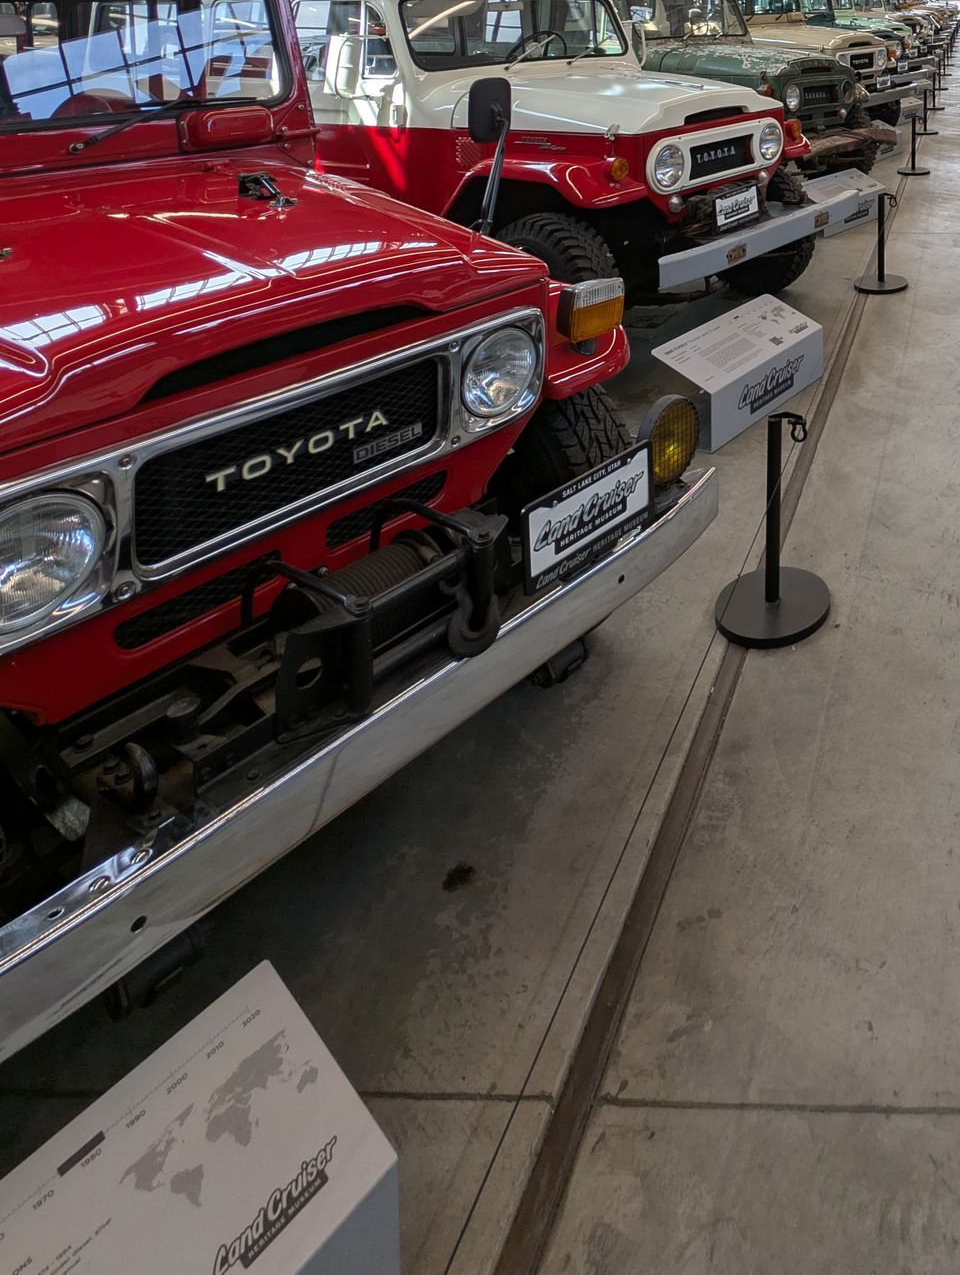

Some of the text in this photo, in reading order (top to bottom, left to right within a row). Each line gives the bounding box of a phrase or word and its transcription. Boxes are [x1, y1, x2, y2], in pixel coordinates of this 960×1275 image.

[738, 354, 804, 410] Land Cruiser
[205, 409, 389, 492] TOYOTA
[355, 423, 422, 463] DIESEL
[562, 460, 621, 498] SALT LAKE CITY, UTAH
[533, 470, 645, 552] Land Cruiser
[560, 504, 623, 547] HERITAGE MUSEUM
[536, 511, 648, 589] Land Cruiser HERITAGE MUSEUM
[240, 1008, 261, 1028] 2020
[206, 1040, 225, 1059] 2010
[166, 1072, 189, 1095] 2000
[125, 1109, 146, 1130] 1990
[80, 1147, 102, 1168] 1980
[32, 1189, 55, 1210] 1970
[212, 1135, 337, 1275] Land Cruiser
[247, 1178, 322, 1259] HERITAGE MUSEUM
